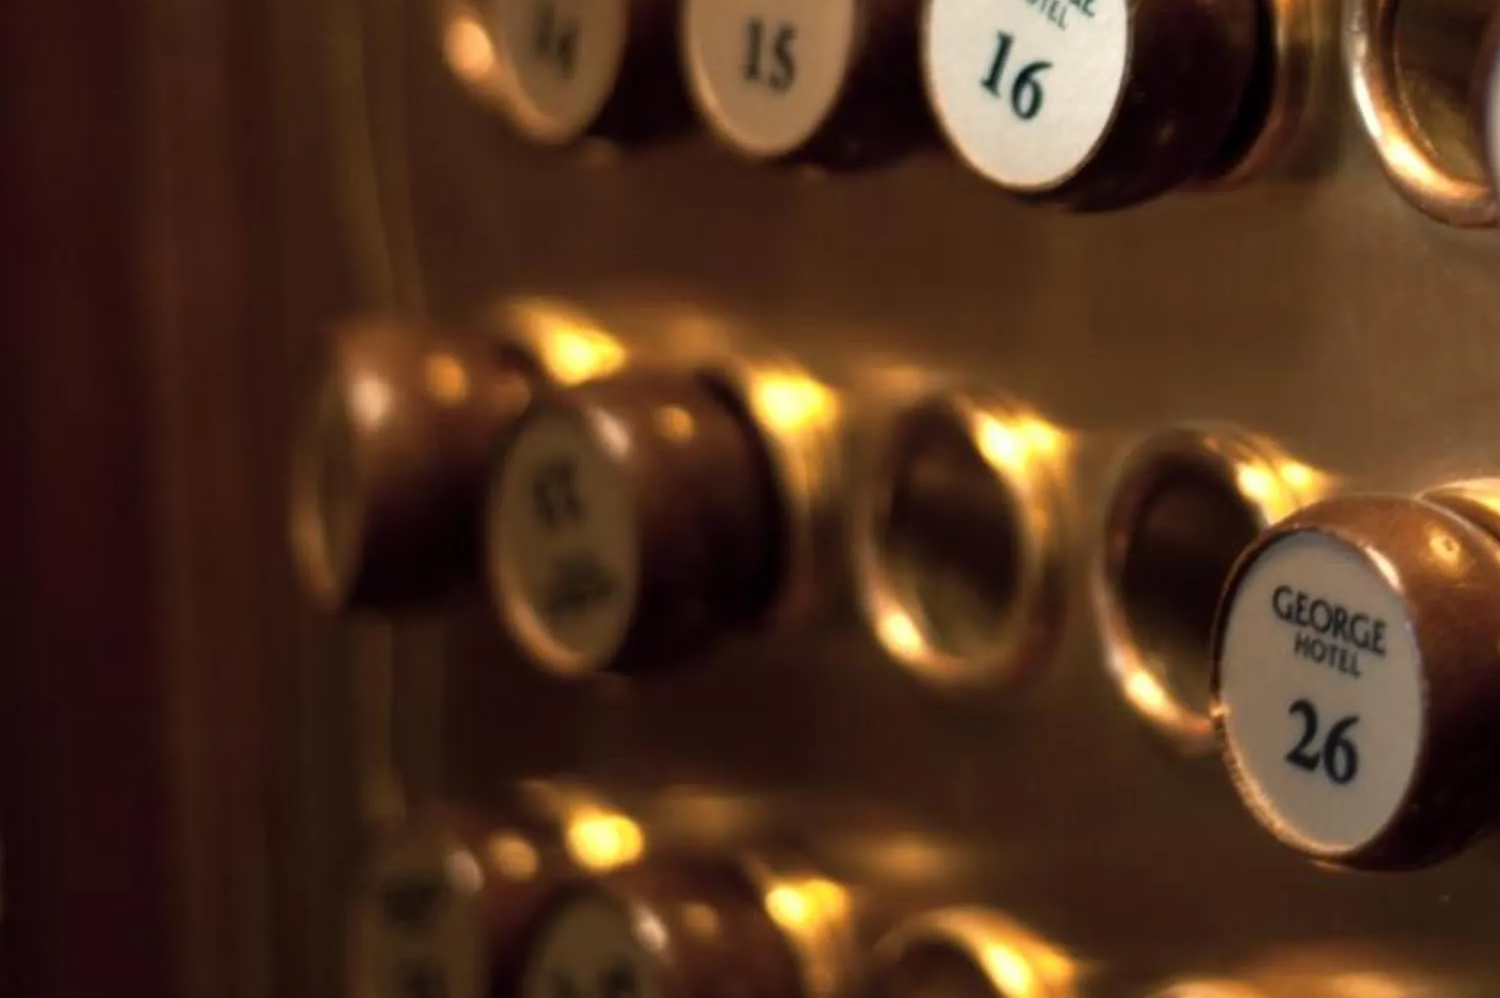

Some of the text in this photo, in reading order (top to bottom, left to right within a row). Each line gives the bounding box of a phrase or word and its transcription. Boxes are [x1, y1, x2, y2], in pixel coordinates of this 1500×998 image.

[741, 15, 797, 93] 15
[980, 30, 1054, 121] 16
[1271, 584, 1388, 658] GEORGE
[1293, 631, 1362, 679] HOTEL
[1285, 698, 1361, 787] 26
